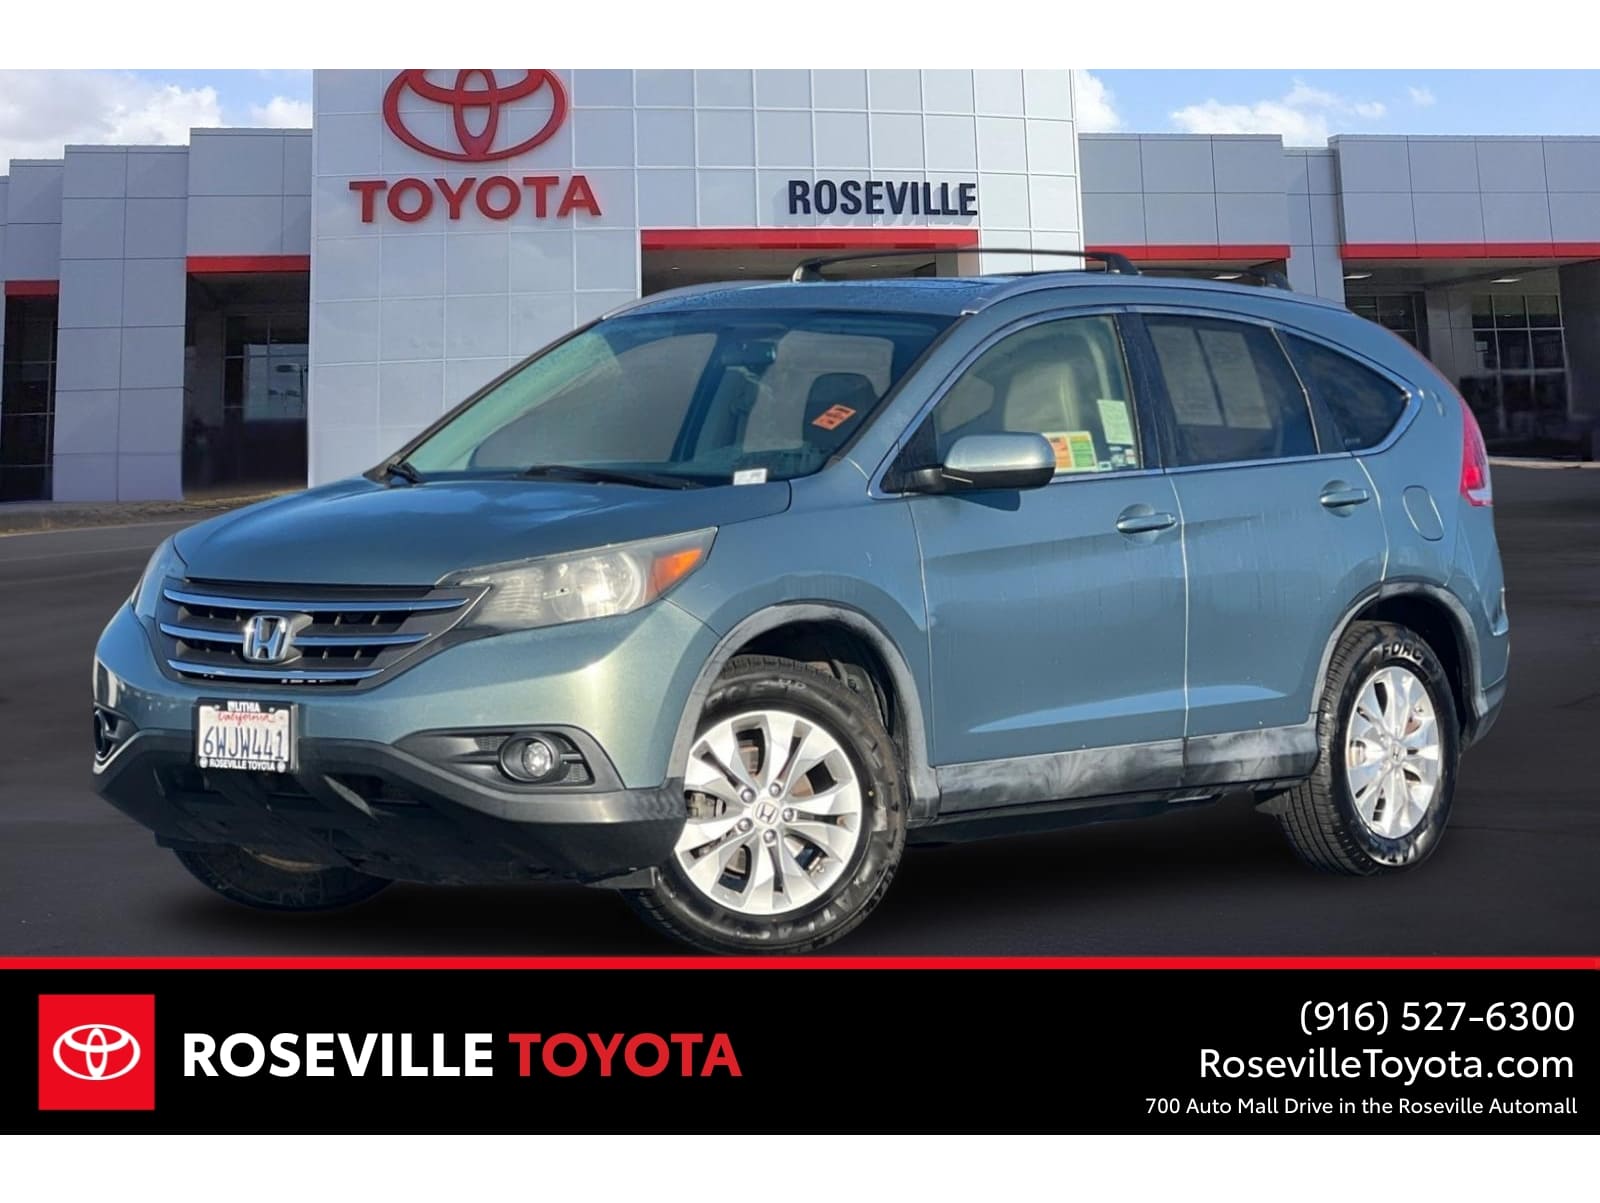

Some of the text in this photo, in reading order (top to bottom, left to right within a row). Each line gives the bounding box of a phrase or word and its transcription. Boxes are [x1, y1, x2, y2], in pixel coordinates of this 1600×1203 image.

[349, 175, 602, 223] TOYOTA
[788, 179, 978, 217] ROSEVILLE
[203, 726, 284, 760] 6WJW441
[209, 758, 276, 772] ROSEVILLE TOYOTA
